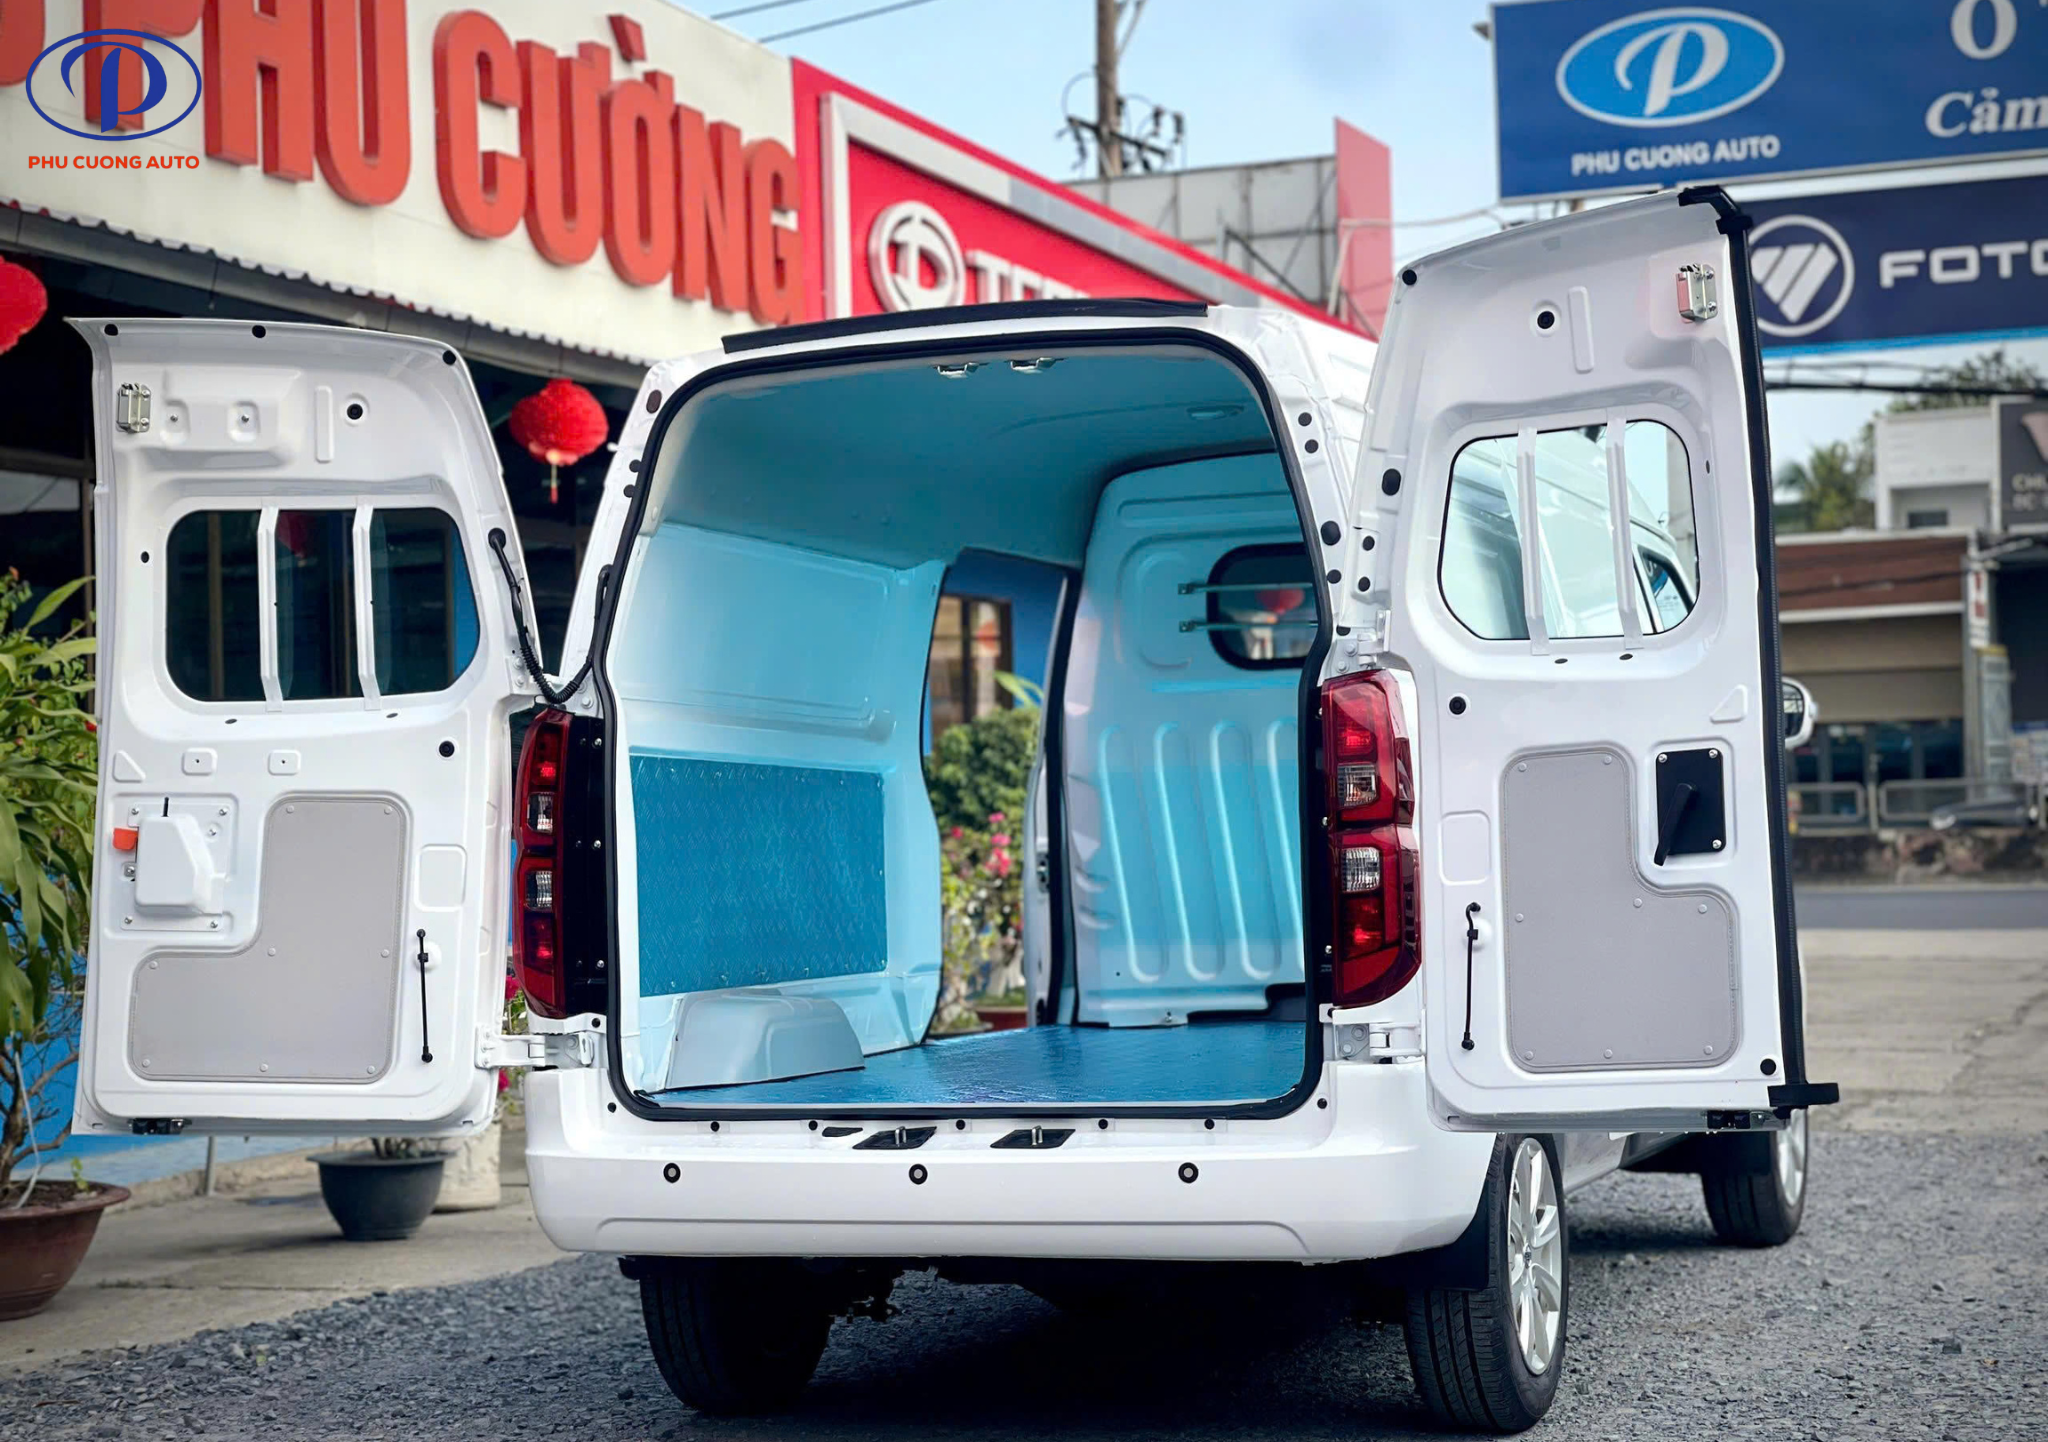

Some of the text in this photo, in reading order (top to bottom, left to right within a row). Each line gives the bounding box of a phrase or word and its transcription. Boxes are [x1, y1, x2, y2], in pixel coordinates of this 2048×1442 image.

[434, 10, 798, 325] CƯỜNG
[1571, 134, 1781, 177] PHU CUONG AUTO
